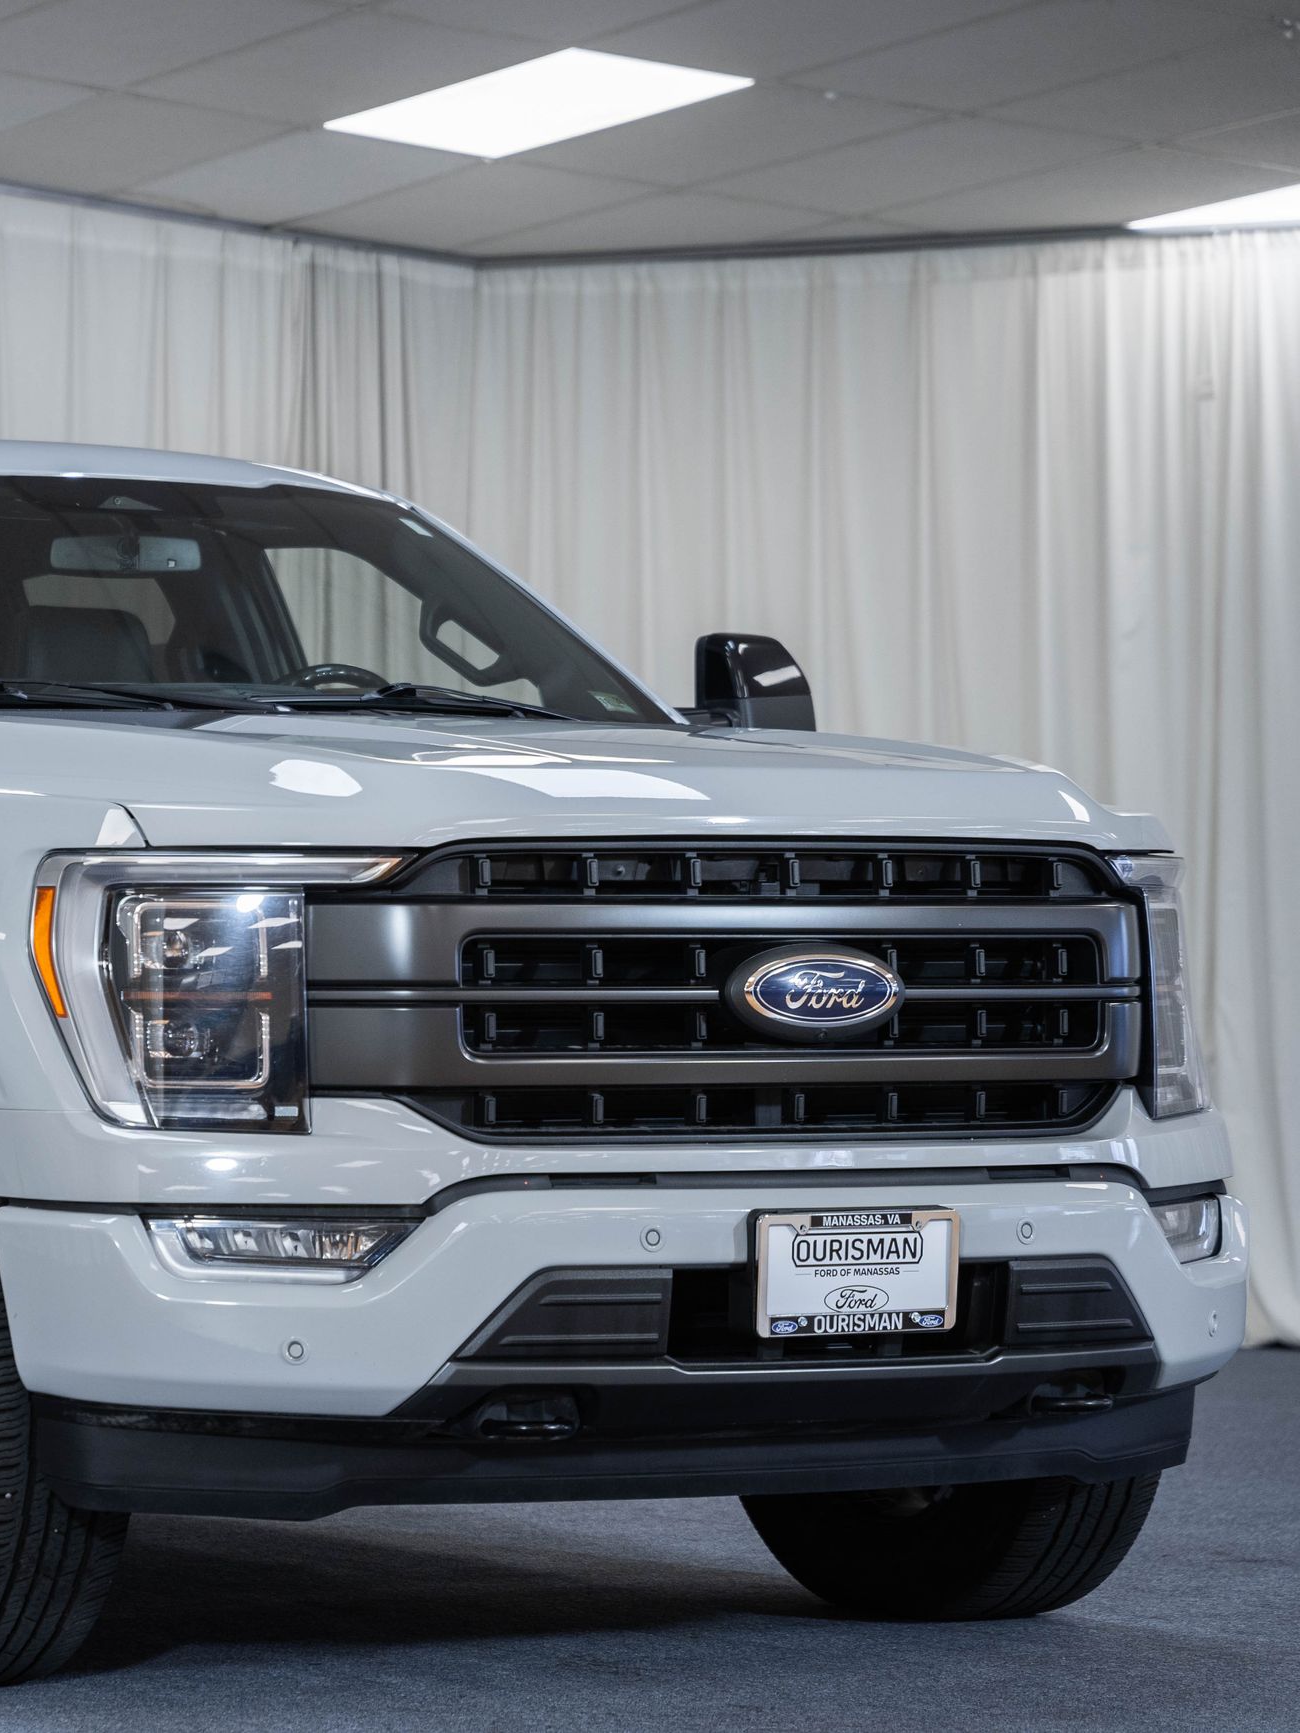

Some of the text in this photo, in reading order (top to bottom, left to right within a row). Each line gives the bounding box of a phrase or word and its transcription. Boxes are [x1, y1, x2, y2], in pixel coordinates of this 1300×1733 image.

[786, 970, 866, 1009] Ford
[822, 1214, 901, 1227] MANASSAS, VA
[796, 1236, 918, 1262] OURISMAN
[814, 1267, 900, 1278] FORD OF MANASSAS
[835, 1288, 877, 1310] Ford
[775, 1322, 794, 1333] Ford
[813, 1313, 903, 1334] OURISMAN
[922, 1316, 940, 1327] Ford
